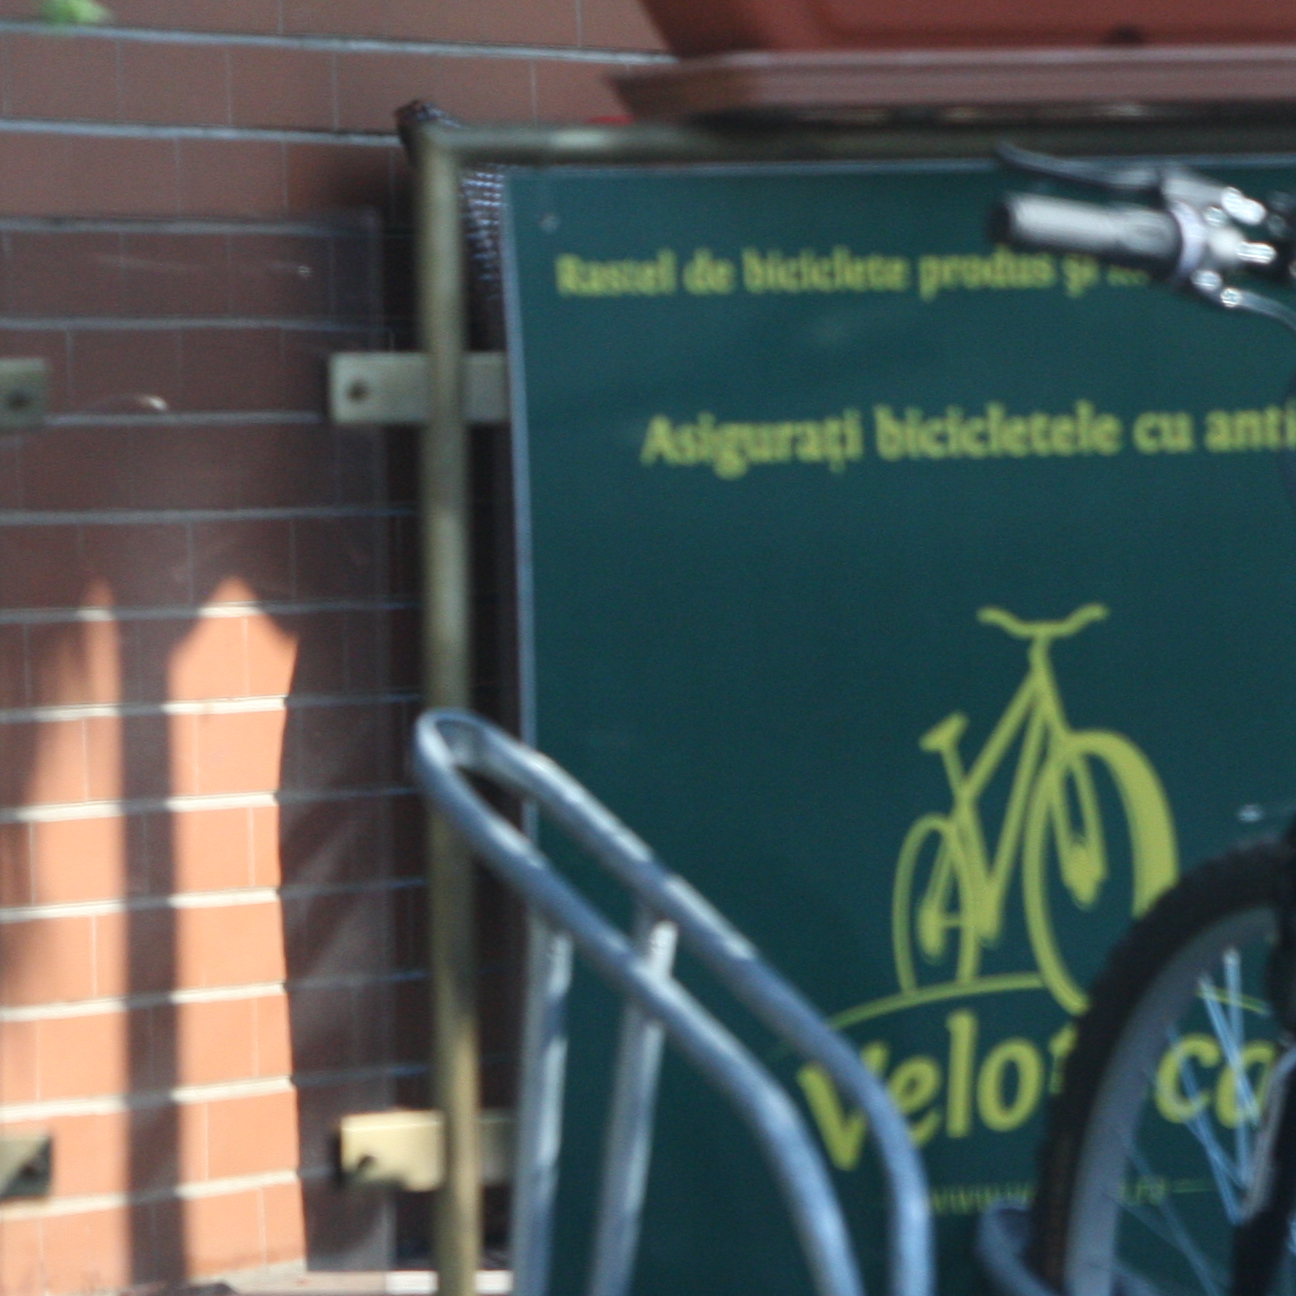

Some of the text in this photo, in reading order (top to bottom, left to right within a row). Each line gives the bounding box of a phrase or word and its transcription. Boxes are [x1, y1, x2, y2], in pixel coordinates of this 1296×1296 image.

[682, 248, 736, 295] de
[742, 245, 908, 294] biciclete
[919, 245, 1056, 301] produs
[640, 408, 866, 481] Asigurați
[874, 402, 1123, 461] bicicletele
[1132, 410, 1195, 454] cu
